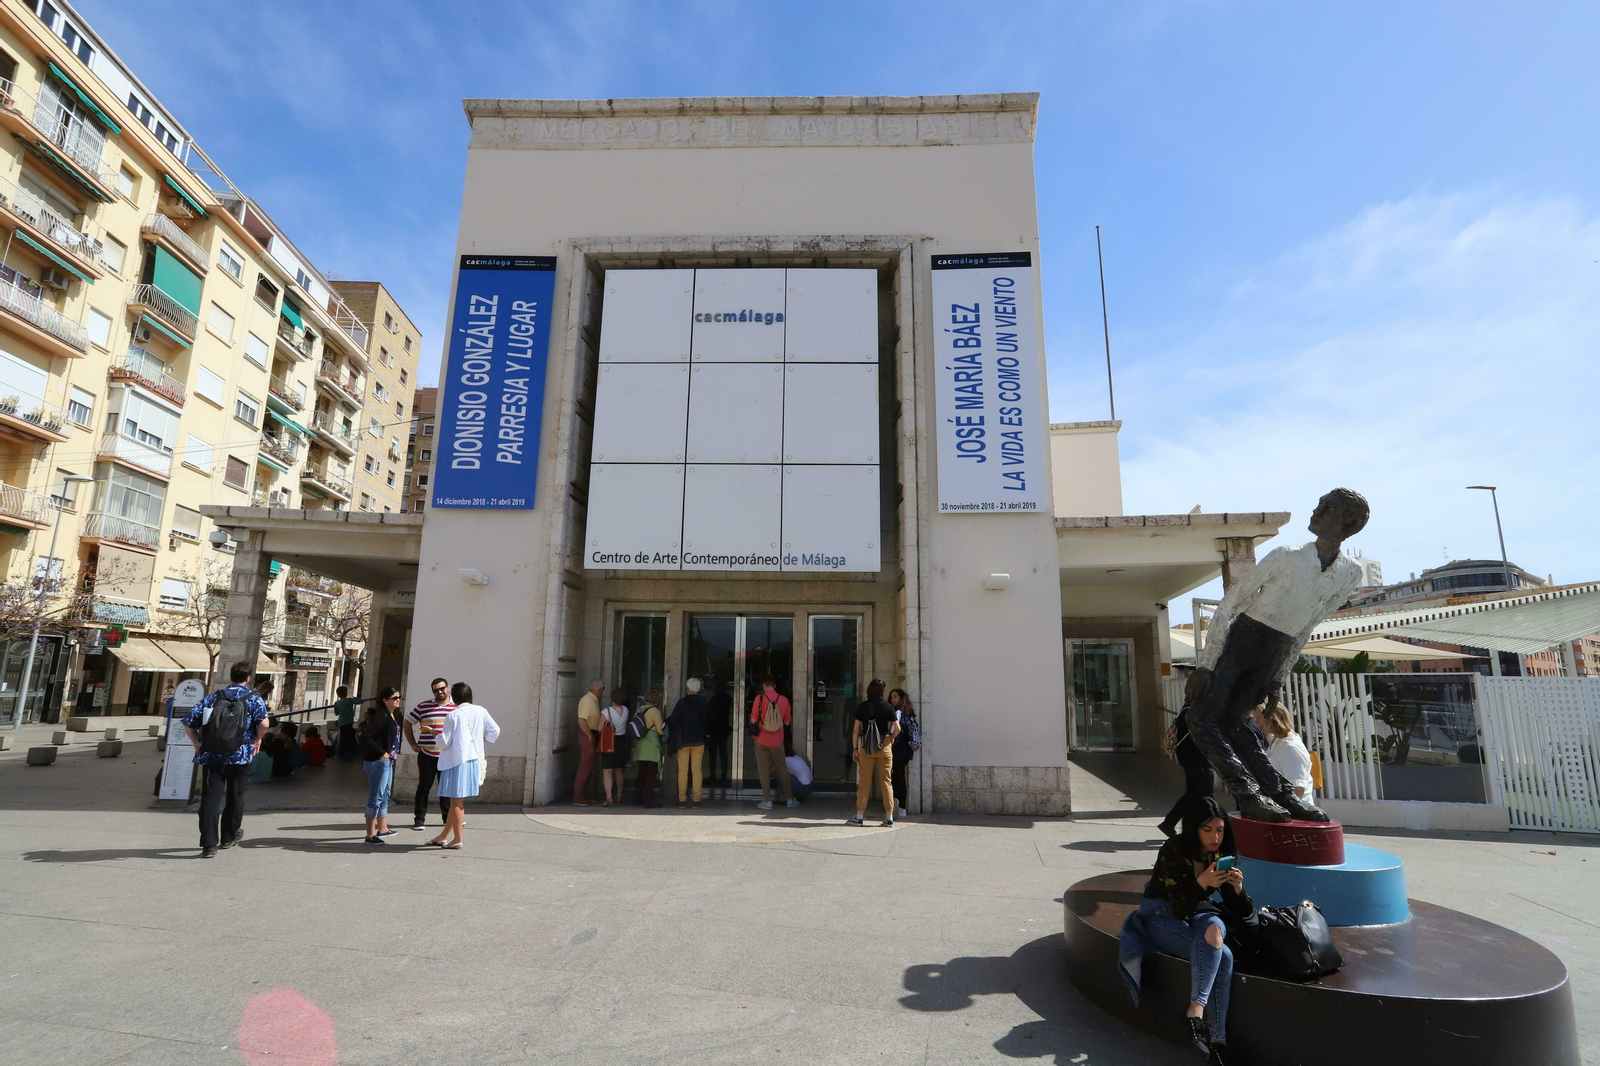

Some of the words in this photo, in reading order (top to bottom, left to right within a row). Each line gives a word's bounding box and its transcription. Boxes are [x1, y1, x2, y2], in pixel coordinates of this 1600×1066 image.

[538, 118, 680, 140] MERCADO
[710, 118, 750, 138] DE
[782, 116, 961, 137] MAYORISTAS
[466, 258, 511, 266] cacmálaga
[695, 309, 784, 325] cacmálaga
[993, 277, 1017, 328] VIENTO
[459, 294, 498, 386] GONZÁLEZ
[507, 300, 537, 358] LUGAR
[944, 303, 981, 348] BÁEZ
[996, 332, 1019, 352] UN
[505, 360, 530, 372] Y
[946, 353, 984, 409] MARÍA
[997, 357, 1022, 402] COMO
[452, 391, 488, 470] DIONISIO
[496, 378, 529, 464] PARRESIA
[999, 407, 1022, 426] ES
[947, 416, 986, 463] JOSÉ
[1001, 431, 1024, 466] VIDA
[1002, 471, 1026, 491] LA
[592, 551, 631, 563] Centro
[634, 552, 649, 564] de
[652, 552, 678, 564] Arte
[683, 552, 779, 567] Contemporáneo
[783, 553, 798, 565] de
[802, 553, 846, 568] Málaga
